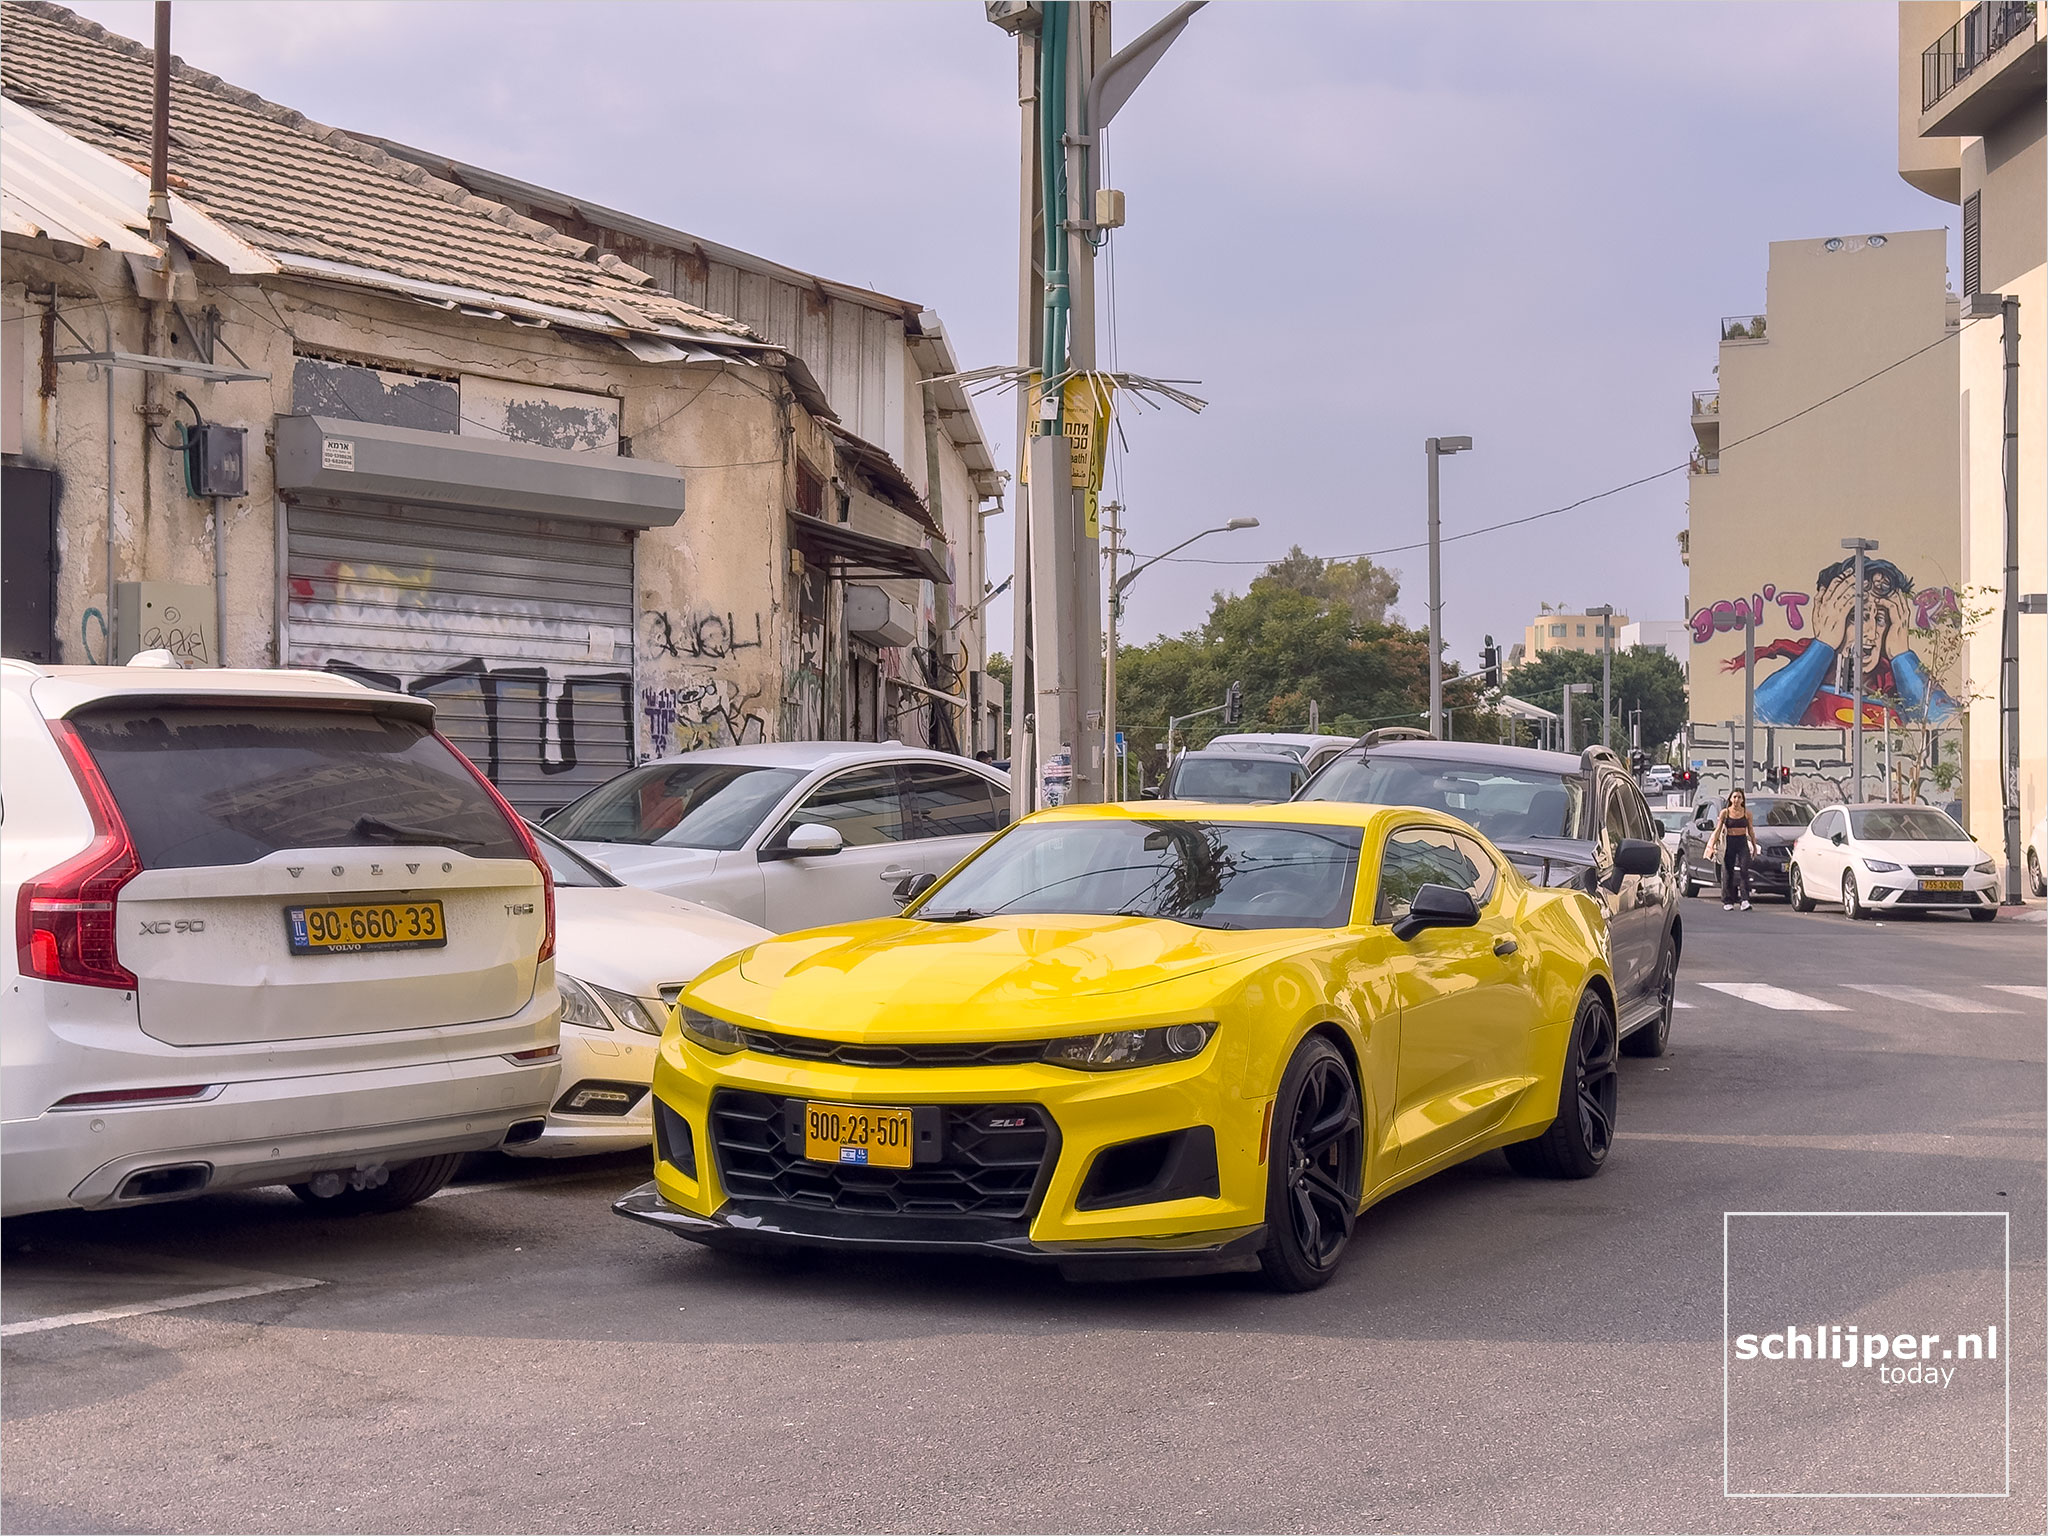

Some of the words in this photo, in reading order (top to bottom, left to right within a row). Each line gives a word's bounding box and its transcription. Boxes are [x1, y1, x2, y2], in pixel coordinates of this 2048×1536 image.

[1064, 422, 1089, 436] מתח
[1070, 437, 1088, 449] סכ
[286, 862, 453, 879] VOLVO
[328, 943, 362, 952] VOLVO
